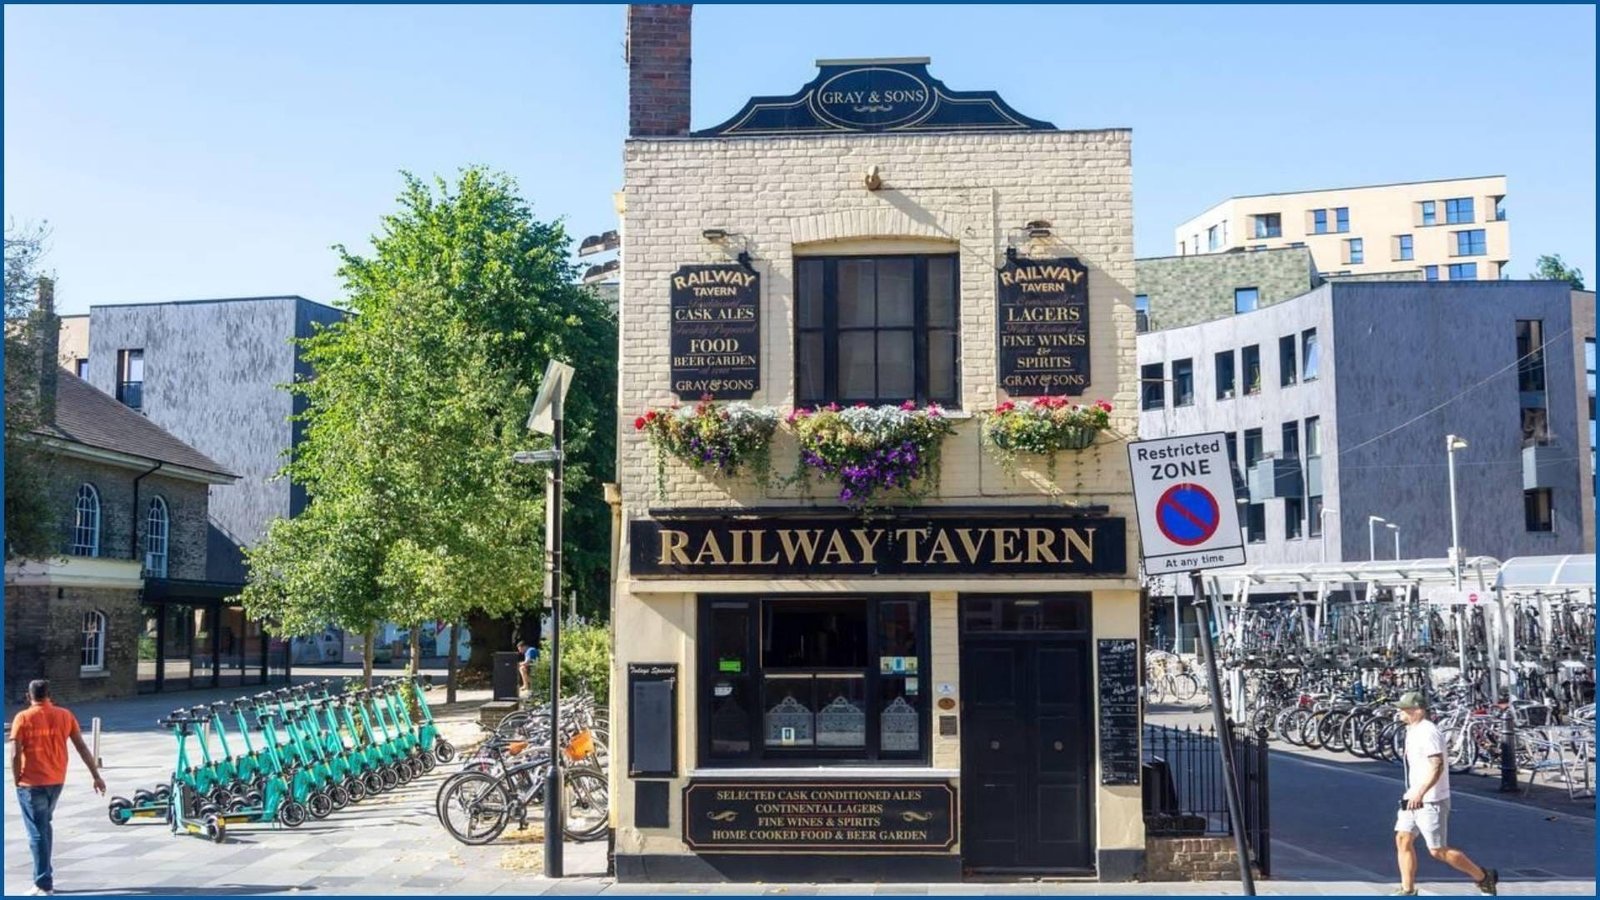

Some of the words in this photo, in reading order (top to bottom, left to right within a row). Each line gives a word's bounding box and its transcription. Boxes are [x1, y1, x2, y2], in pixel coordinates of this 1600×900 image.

[822, 91, 864, 104] GRAY
[868, 90, 880, 103] &
[884, 90, 924, 102] SONS
[673, 270, 756, 290] RAILWAY
[1000, 266, 1084, 286] RAILWAY
[693, 287, 737, 296] TAVERN
[1021, 283, 1065, 292] TAVERN
[675, 308, 713, 320] CASK
[718, 308, 755, 320] ALES
[1008, 307, 1080, 322] LAGERS
[690, 338, 739, 353] FOOD
[1002, 335, 1035, 347] FINE
[1038, 334, 1086, 346] WINES
[674, 355, 705, 367] BEER
[706, 355, 756, 366] GARDEN
[1017, 357, 1071, 369] SPIRITS
[676, 380, 707, 391] GRAY
[708, 379, 722, 391] &
[723, 379, 754, 390] SONS
[1005, 375, 1038, 386] GRAY
[1039, 374, 1052, 387] &
[1053, 374, 1084, 385] SONS
[1137, 440, 1220, 460] Restricted
[1150, 459, 1211, 480] ZONE
[658, 528, 886, 565] RAILWAY
[896, 527, 1097, 565] TAVERN
[1165, 558, 1178, 568] At
[1180, 556, 1199, 567] any
[1201, 553, 1225, 564] time
[717, 790, 776, 800] SELECTED
[778, 790, 808, 800] CASK
[811, 790, 891, 800] CONDITIONED
[893, 790, 922, 800] ALES
[755, 804, 836, 813] CONTINENTAL
[838, 804, 883, 814] LAGERS
[758, 817, 785, 826] FINE
[787, 817, 823, 826] WINES
[825, 817, 835, 827] &
[837, 817, 880, 827] SPIRITS
[712, 830, 747, 839] HOME
[749, 830, 798, 839] COOKED
[800, 830, 832, 839] FOOD
[835, 830, 844, 840] &
[847, 830, 877, 840] BEER
[879, 830, 927, 840] GARDEN
